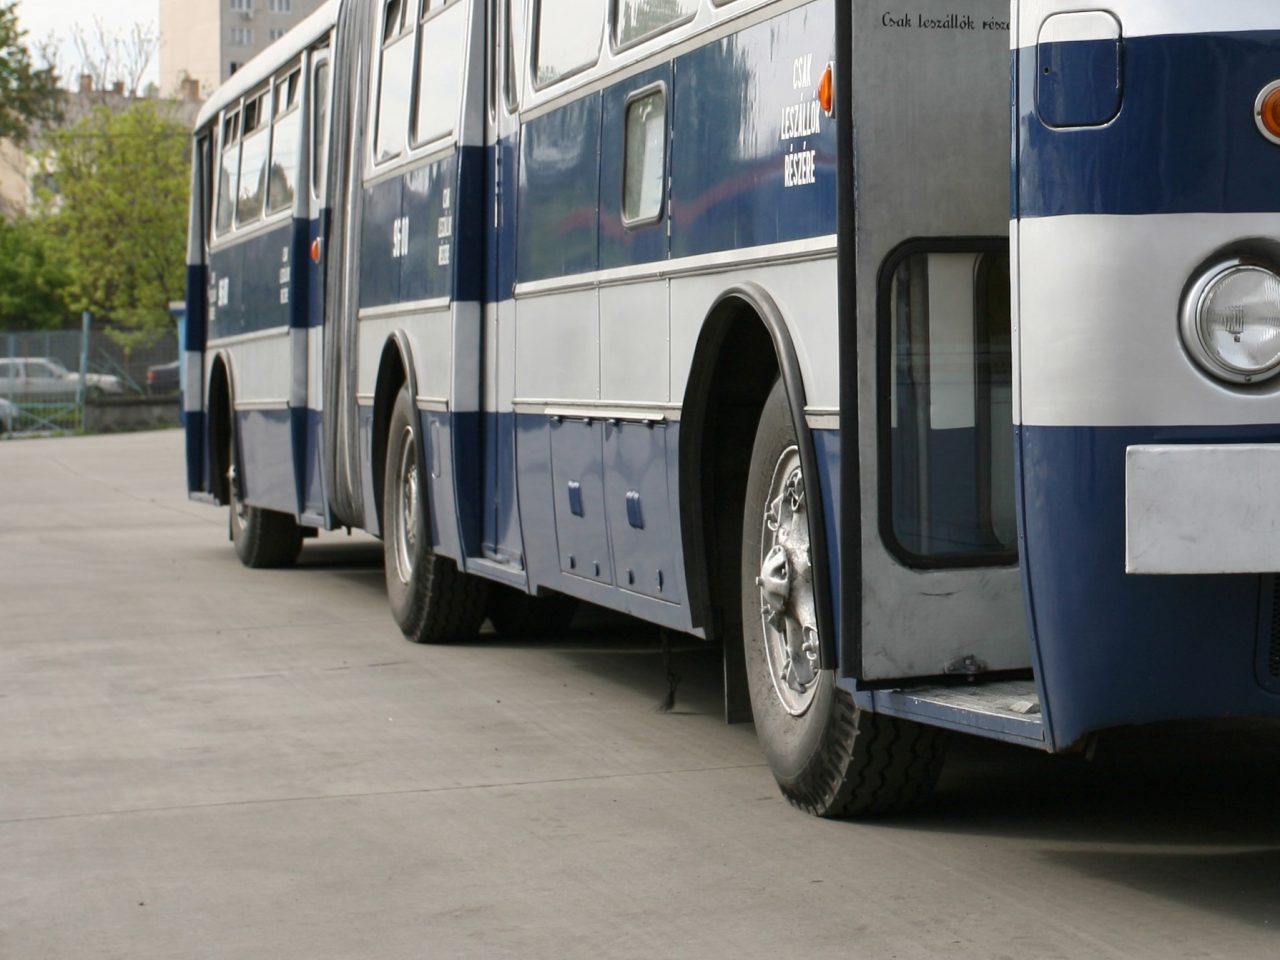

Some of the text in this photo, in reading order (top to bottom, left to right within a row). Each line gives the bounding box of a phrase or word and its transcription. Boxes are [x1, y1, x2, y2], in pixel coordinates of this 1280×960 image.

[882, 11, 912, 28] Csak
[918, 13, 975, 30] leszállók
[793, 53, 812, 89] CSAK
[781, 90, 820, 140] LESZÁLLÓK
[785, 141, 815, 187] RÉSZÉRE
